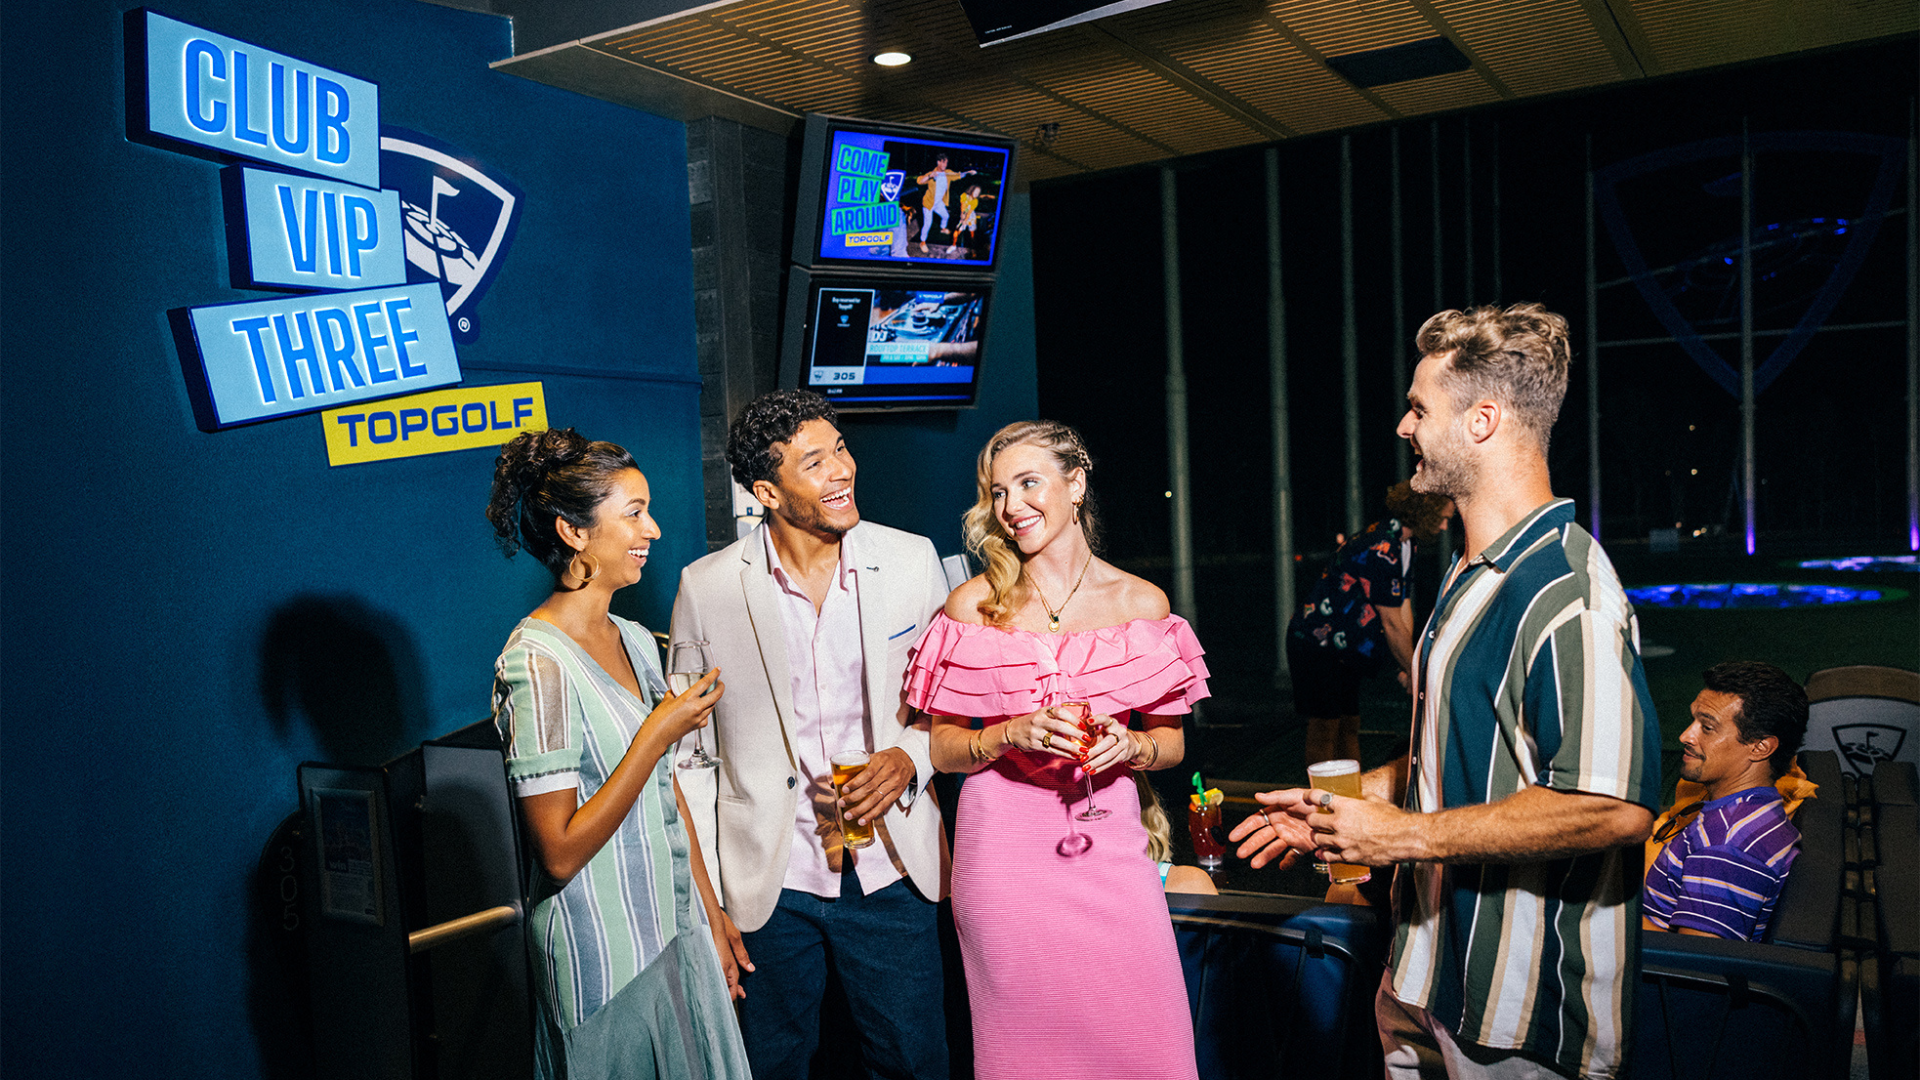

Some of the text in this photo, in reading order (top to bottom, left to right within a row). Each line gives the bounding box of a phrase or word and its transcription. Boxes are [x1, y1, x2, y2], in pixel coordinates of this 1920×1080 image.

[183, 38, 351, 165] CLUB
[839, 146, 888, 177] COME
[840, 177, 880, 202] PLAY
[276, 183, 379, 278] VIP
[834, 203, 898, 233] AROUND
[848, 234, 890, 243] TOPGOLF
[231, 297, 428, 405] THREE
[833, 372, 855, 381] 305
[337, 397, 534, 447] TOPGOLF
